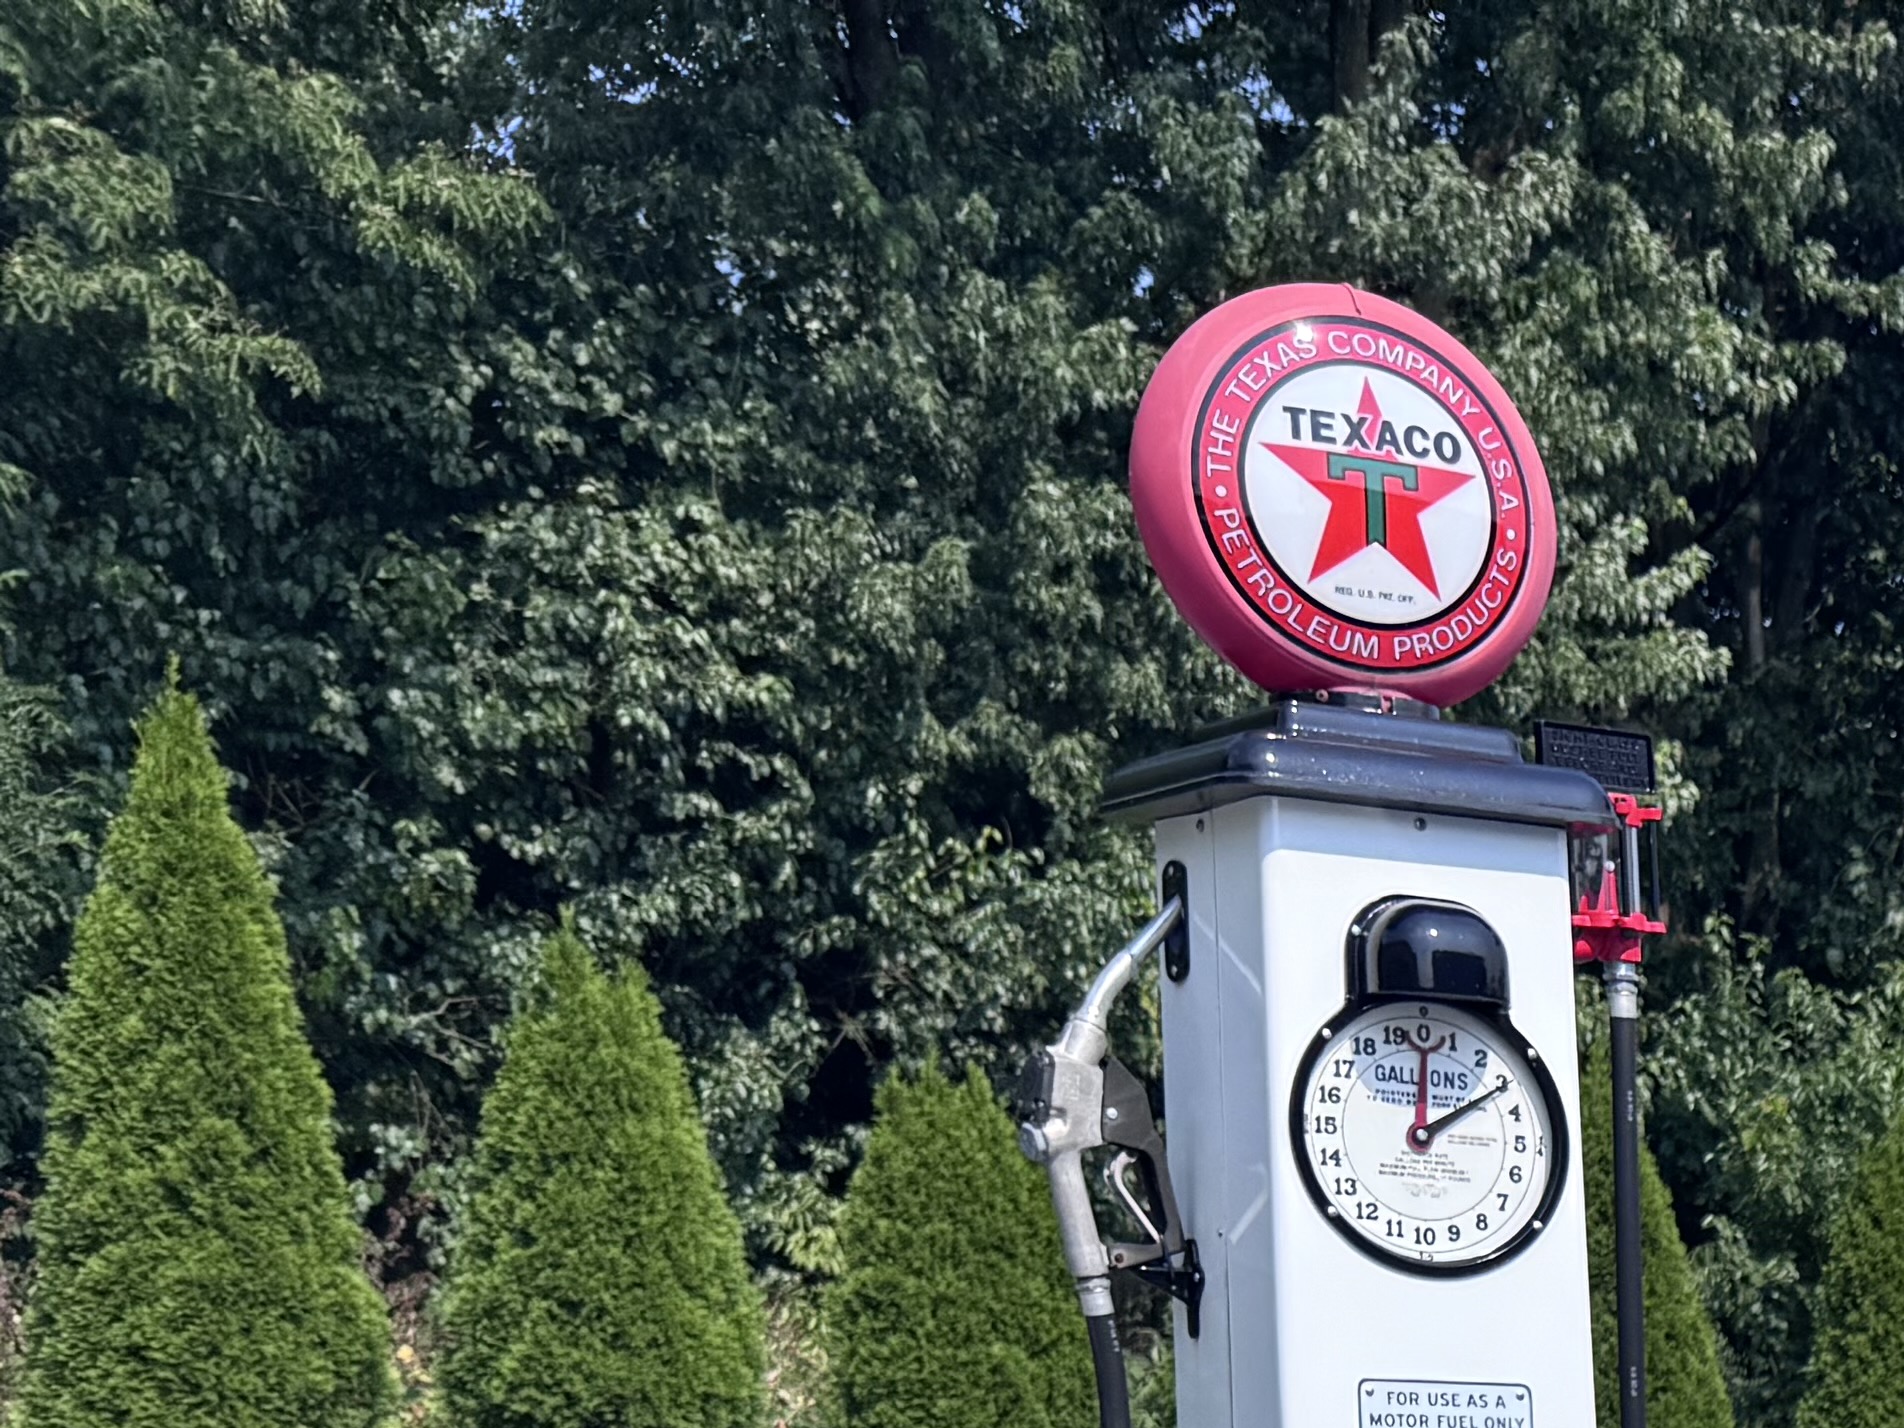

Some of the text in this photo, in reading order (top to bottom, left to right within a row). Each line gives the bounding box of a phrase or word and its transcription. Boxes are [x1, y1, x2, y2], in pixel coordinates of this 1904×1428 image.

[1206, 413, 1240, 479] THE
[1225, 335, 1318, 403] TEXAS
[1327, 330, 1481, 418] COMPANY
[1283, 405, 1462, 465] TEXACO
[1213, 507, 1518, 661] PETROLEUM PRODUCTS
[1383, 1026, 1406, 1046] 19
[1417, 1025, 1431, 1043] 0
[1448, 1033, 1458, 1052] 1
[1353, 1036, 1377, 1056] 18
[1474, 1050, 1489, 1068] 2
[1333, 1060, 1355, 1079] 17
[1374, 1064, 1468, 1091] GALLONS
[1496, 1074, 1509, 1093] 3
[1318, 1086, 1341, 1104] 16
[1508, 1105, 1522, 1123] 4
[1314, 1116, 1338, 1135] 15
[1514, 1136, 1527, 1154] 5
[1320, 1148, 1342, 1167] 14
[1510, 1166, 1523, 1184] 6
[1334, 1178, 1358, 1196] 13
[1356, 1202, 1379, 1221] 12
[1497, 1194, 1509, 1213] 7
[1386, 1220, 1405, 1238] 11
[1475, 1214, 1489, 1231] 8
[1414, 1227, 1436, 1246] 10
[1448, 1225, 1461, 1242] 9
[1387, 1391, 1506, 1409] FOR USE AS A
[1369, 1413, 1429, 1428] MOTOR
